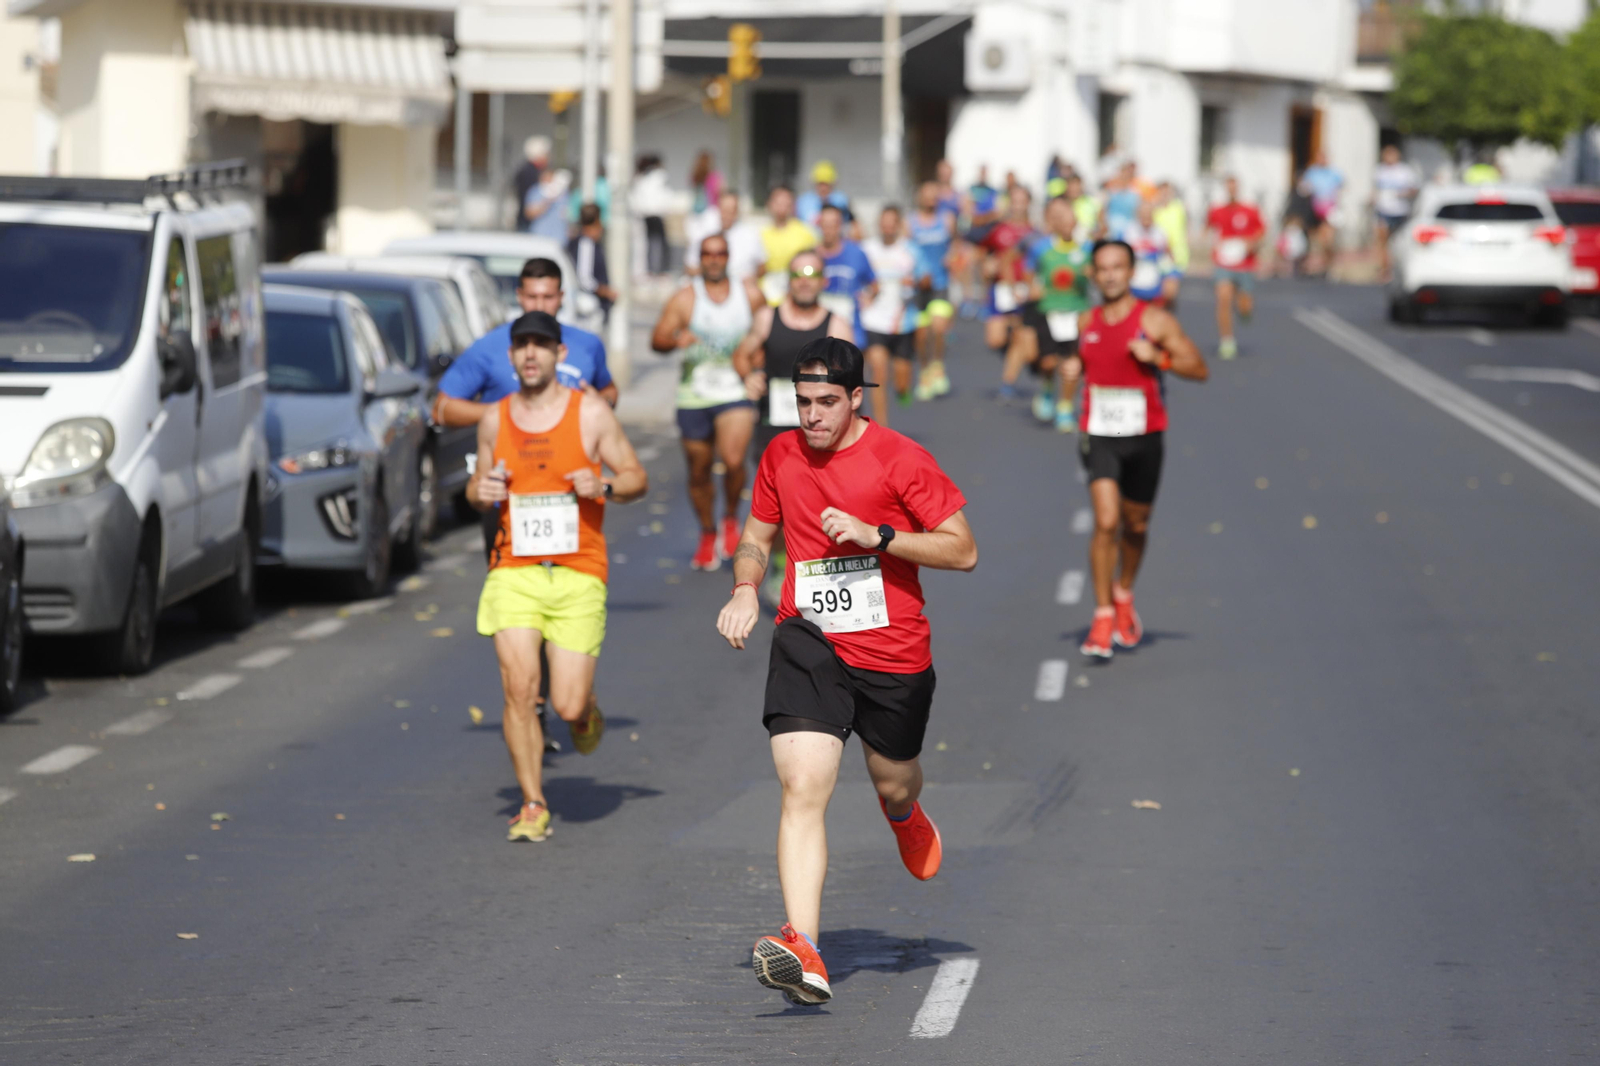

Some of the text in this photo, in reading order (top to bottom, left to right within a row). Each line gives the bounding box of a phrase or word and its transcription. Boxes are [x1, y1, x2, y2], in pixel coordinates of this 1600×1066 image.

[523, 519, 553, 538] 128
[810, 562, 837, 575] VUELTA
[838, 562, 844, 571] A
[844, 558, 874, 571] HUELVA
[812, 588, 852, 614] 599
